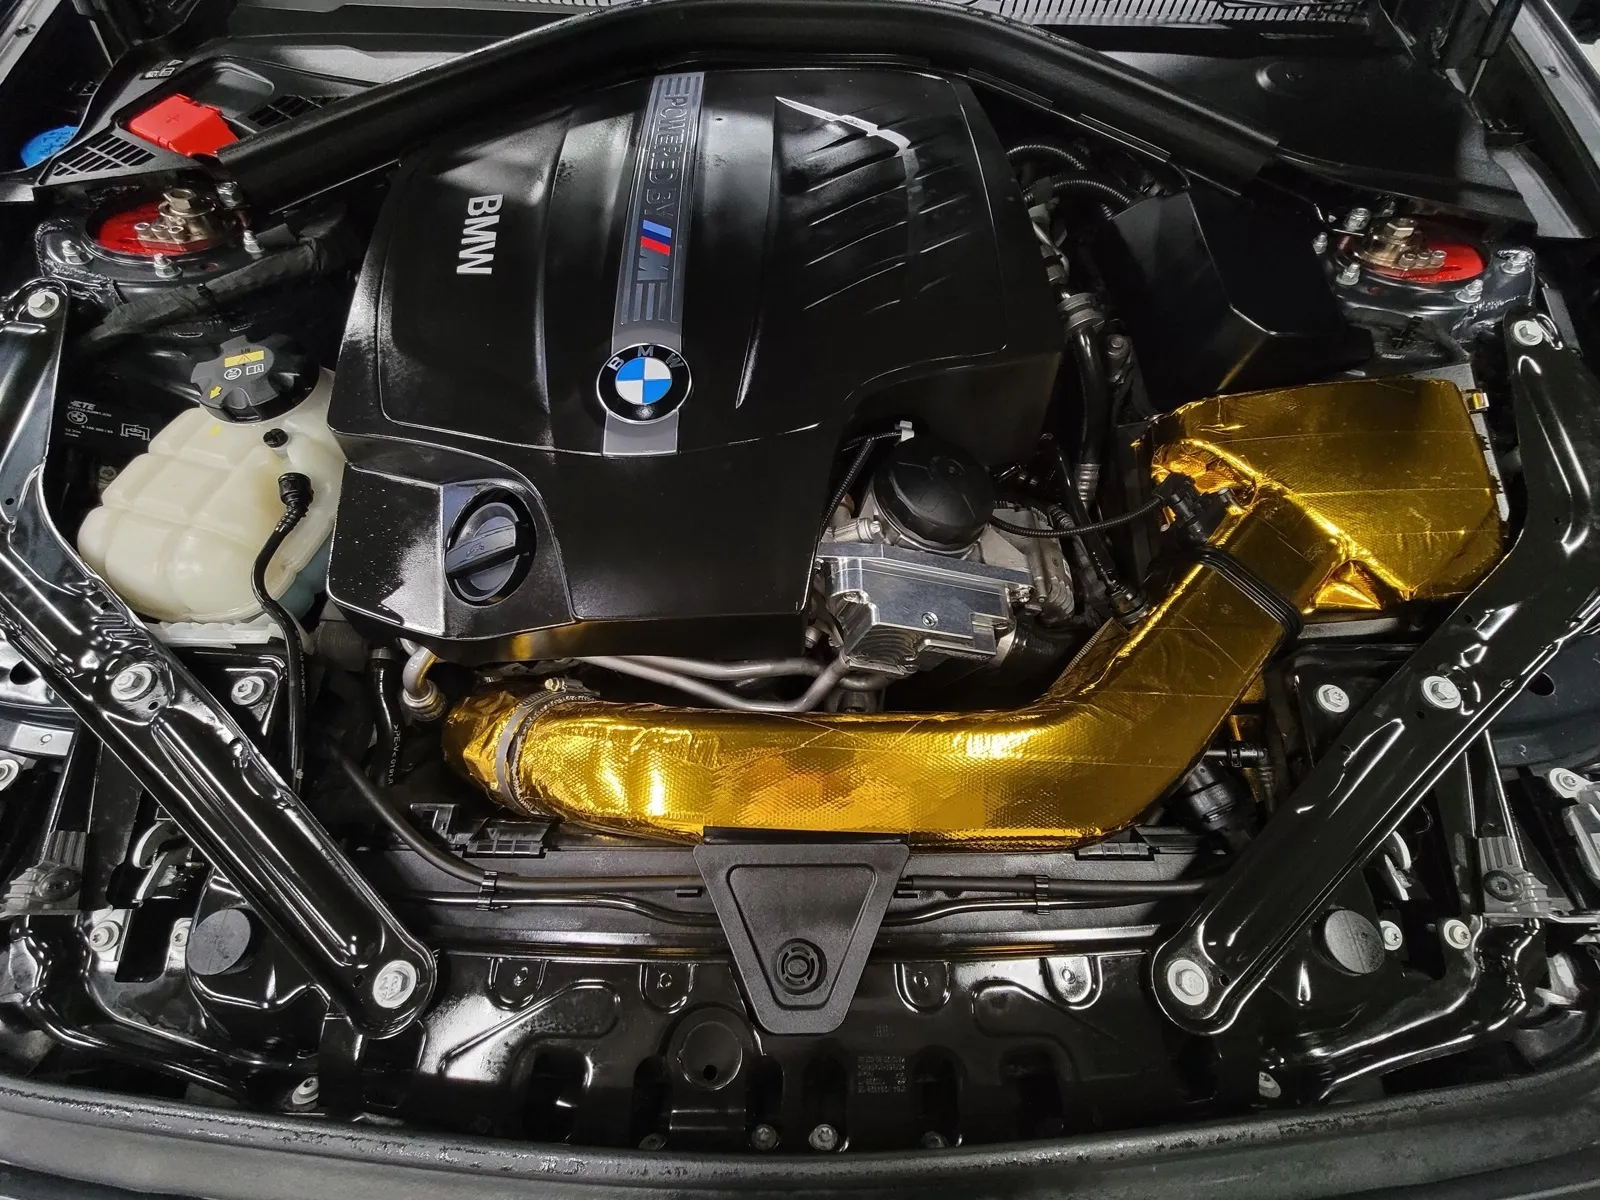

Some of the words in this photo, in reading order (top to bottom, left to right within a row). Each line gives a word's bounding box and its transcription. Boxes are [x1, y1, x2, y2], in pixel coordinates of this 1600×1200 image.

[648, 95, 689, 184] POWERED
[643, 187, 678, 216] BY
[456, 194, 504, 275] BMW
[606, 345, 685, 372] BMW
